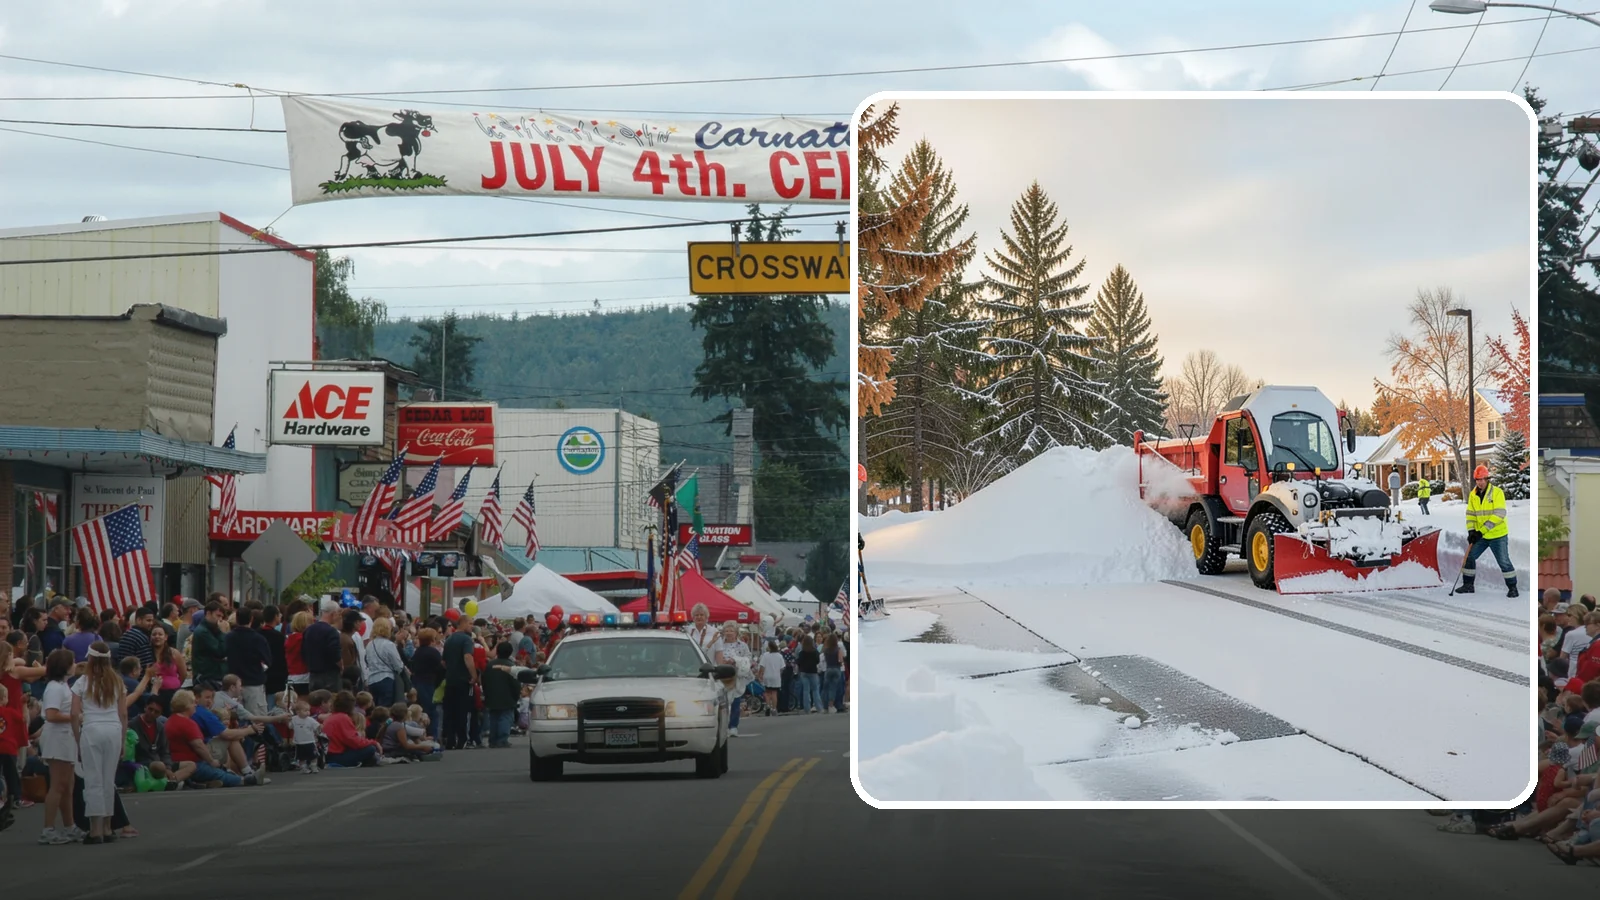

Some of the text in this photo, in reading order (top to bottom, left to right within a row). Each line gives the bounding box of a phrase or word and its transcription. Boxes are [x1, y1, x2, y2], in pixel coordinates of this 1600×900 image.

[481, 141, 605, 192] JULY
[632, 150, 746, 198] 4th.
[697, 254, 850, 280] CROSSWA
[283, 380, 373, 420] ACE
[405, 409, 485, 422] CEDAR LOG
[284, 421, 370, 436] Hardware
[416, 428, 477, 447] Coca-Cola
[353, 467, 385, 480] Simpl
[83, 484, 155, 495] St. Vincent de Paul
[688, 526, 741, 535] CRNATION
[699, 535, 730, 543] GLASS
